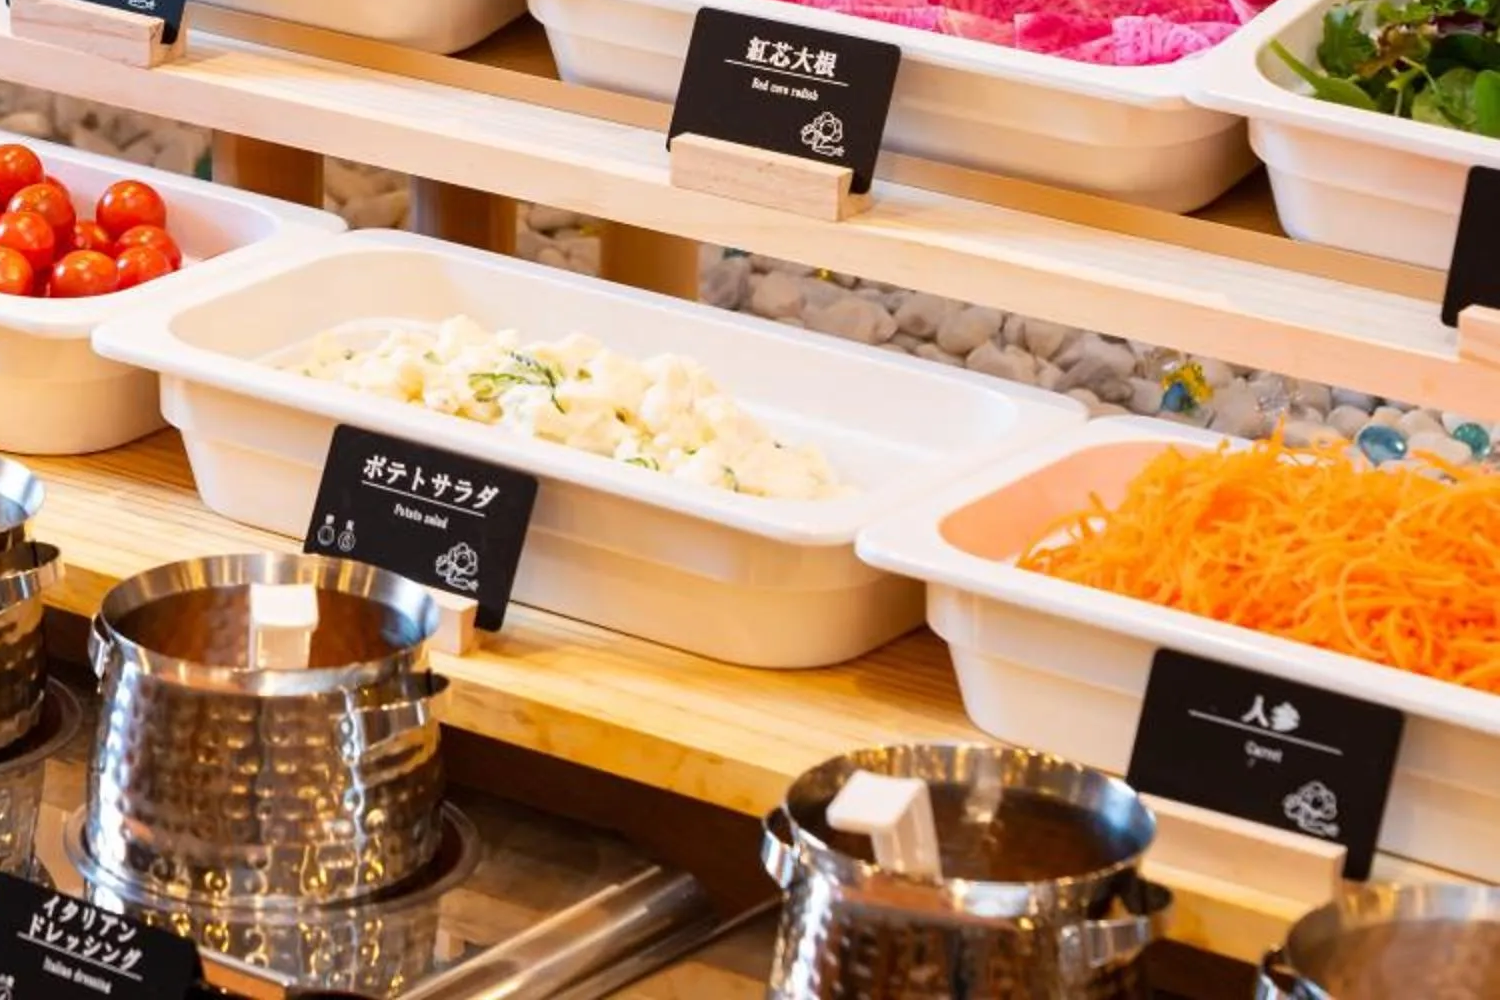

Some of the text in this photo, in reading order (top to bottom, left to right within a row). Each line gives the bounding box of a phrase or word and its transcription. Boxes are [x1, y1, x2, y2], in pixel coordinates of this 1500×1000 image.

[746, 36, 838, 77] 紅芯大根
[362, 454, 499, 509] ポテトサラダ
[29, 913, 143, 971] ドレッシング
[43, 895, 136, 942] イタリアン
